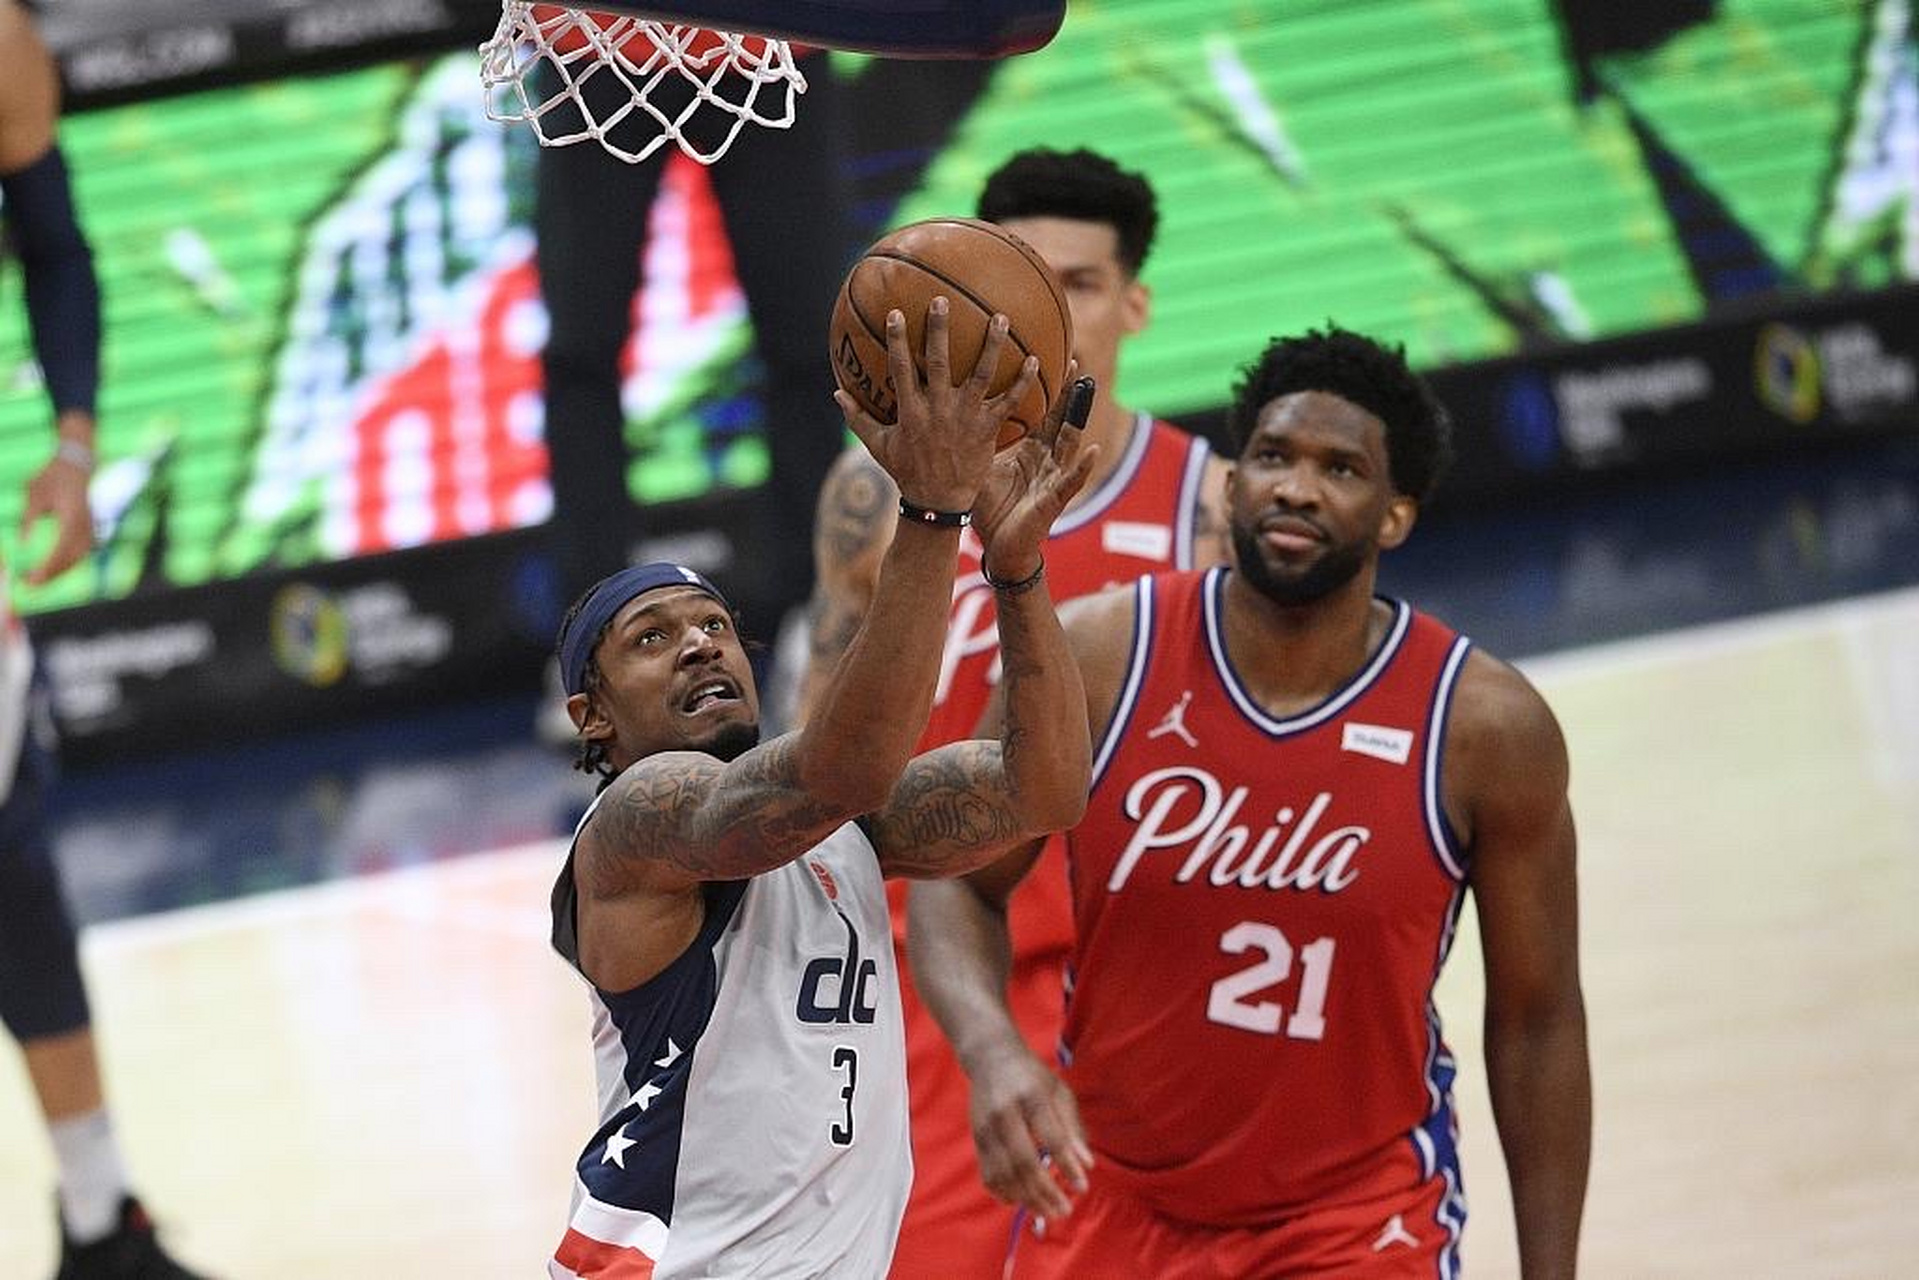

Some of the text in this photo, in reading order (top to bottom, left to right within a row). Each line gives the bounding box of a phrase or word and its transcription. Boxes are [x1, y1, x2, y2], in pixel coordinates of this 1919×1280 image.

[1107, 765, 1372, 893] Phila
[1206, 920, 1336, 1040] 21
[830, 1047, 858, 1147] 3
